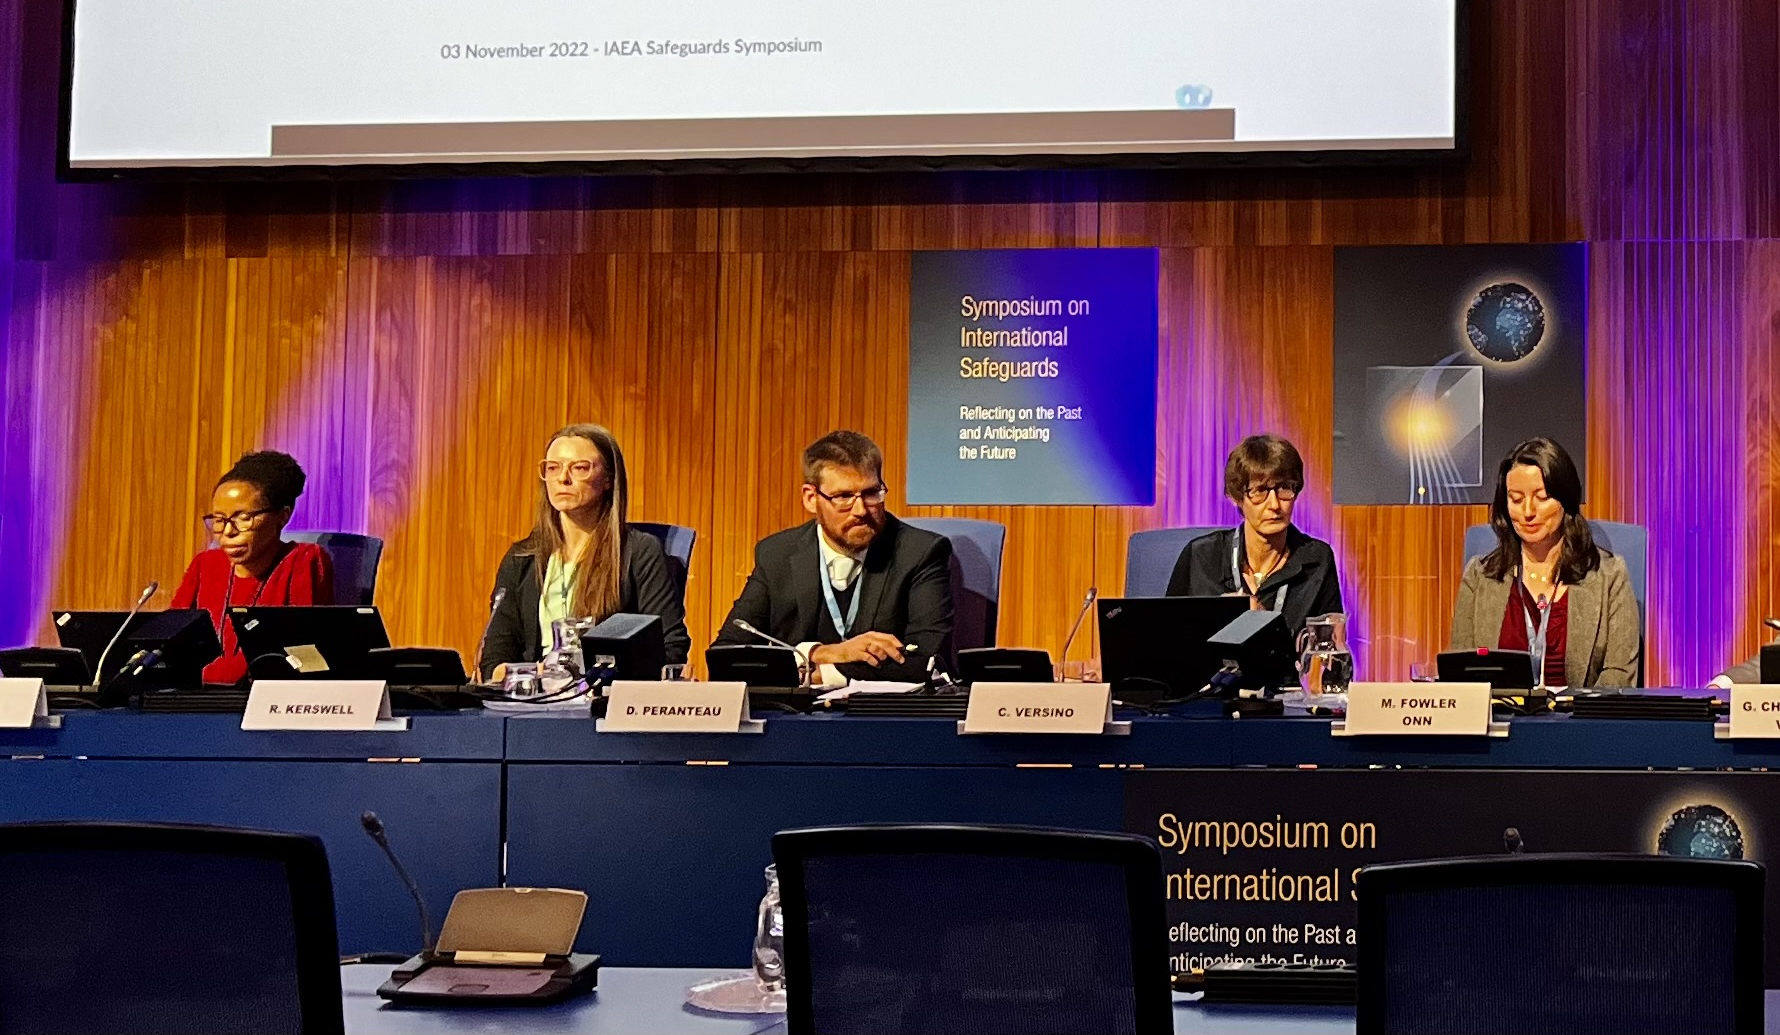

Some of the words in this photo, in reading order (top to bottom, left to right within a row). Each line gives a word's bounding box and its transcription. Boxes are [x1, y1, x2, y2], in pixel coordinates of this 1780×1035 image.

[441, 44, 460, 59] 03
[466, 43, 545, 58] November
[549, 42, 588, 57] 2022
[605, 41, 642, 56] IAEA
[647, 39, 729, 57] Safeguards
[735, 37, 822, 56] Symposium
[961, 295, 1062, 322] Symposium
[1068, 300, 1089, 315] on
[960, 326, 1068, 348] International
[960, 357, 1058, 381] Safeguards
[960, 405, 1015, 422] Reflecting
[1019, 409, 1032, 419] on
[1036, 406, 1054, 419] the
[1058, 406, 1082, 419] Past
[960, 426, 981, 439] and
[984, 426, 1049, 442] Anticipating
[959, 446, 977, 459] the
[981, 445, 1017, 459] Future
[269, 704, 281, 714] R.
[286, 705, 353, 714] KERSWELL
[626, 706, 638, 717] D.
[643, 707, 721, 716] PERANTEAU
[1382, 699, 1395, 708] M.
[1401, 699, 1456, 708] FOWLER
[1743, 702, 1756, 711] G.
[999, 708, 1011, 716] C.
[1016, 708, 1073, 717] VERSINO
[1403, 717, 1431, 725] ONN
[1159, 814, 1328, 855] Symposium
[1341, 823, 1375, 848] on
[1167, 868, 1338, 901] nternational
[1169, 922, 1239, 947] eflecting
[1246, 928, 1266, 943] on
[1272, 924, 1298, 943] the
[1305, 924, 1340, 944] Past
